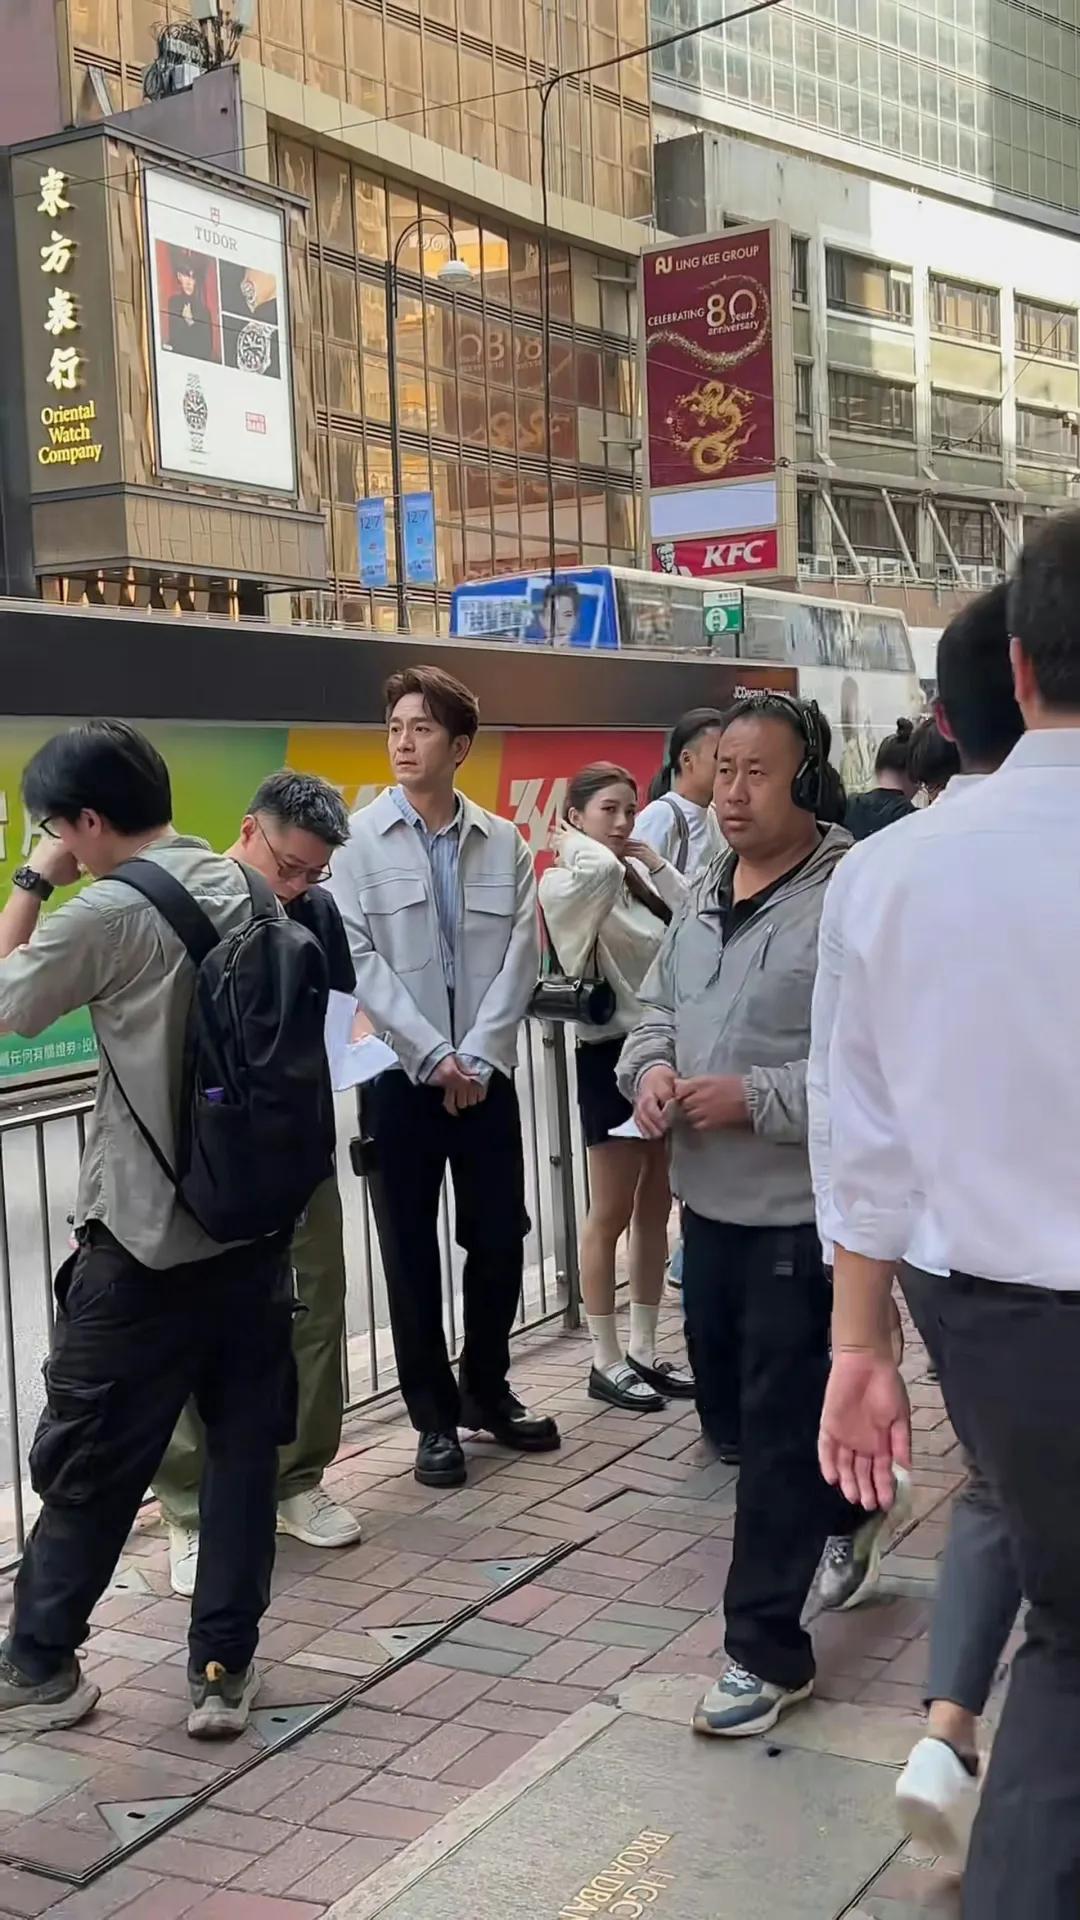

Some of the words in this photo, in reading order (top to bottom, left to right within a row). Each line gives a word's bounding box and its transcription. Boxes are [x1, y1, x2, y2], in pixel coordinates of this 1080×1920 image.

[194, 226, 238, 251] TUDOR
[675, 256, 699, 271] LING
[702, 253, 720, 266] KEE
[722, 245, 760, 262] GROUP
[647, 307, 705, 327] CELEBRATING
[706, 289, 757, 327] 80
[707, 319, 760, 336] anniversary
[41, 401, 95, 425] Oriental
[49, 423, 90, 444] Watch
[38, 444, 102, 465] Company
[702, 540, 768, 569] KFC
[608, 1866, 678, 1919] HGC
